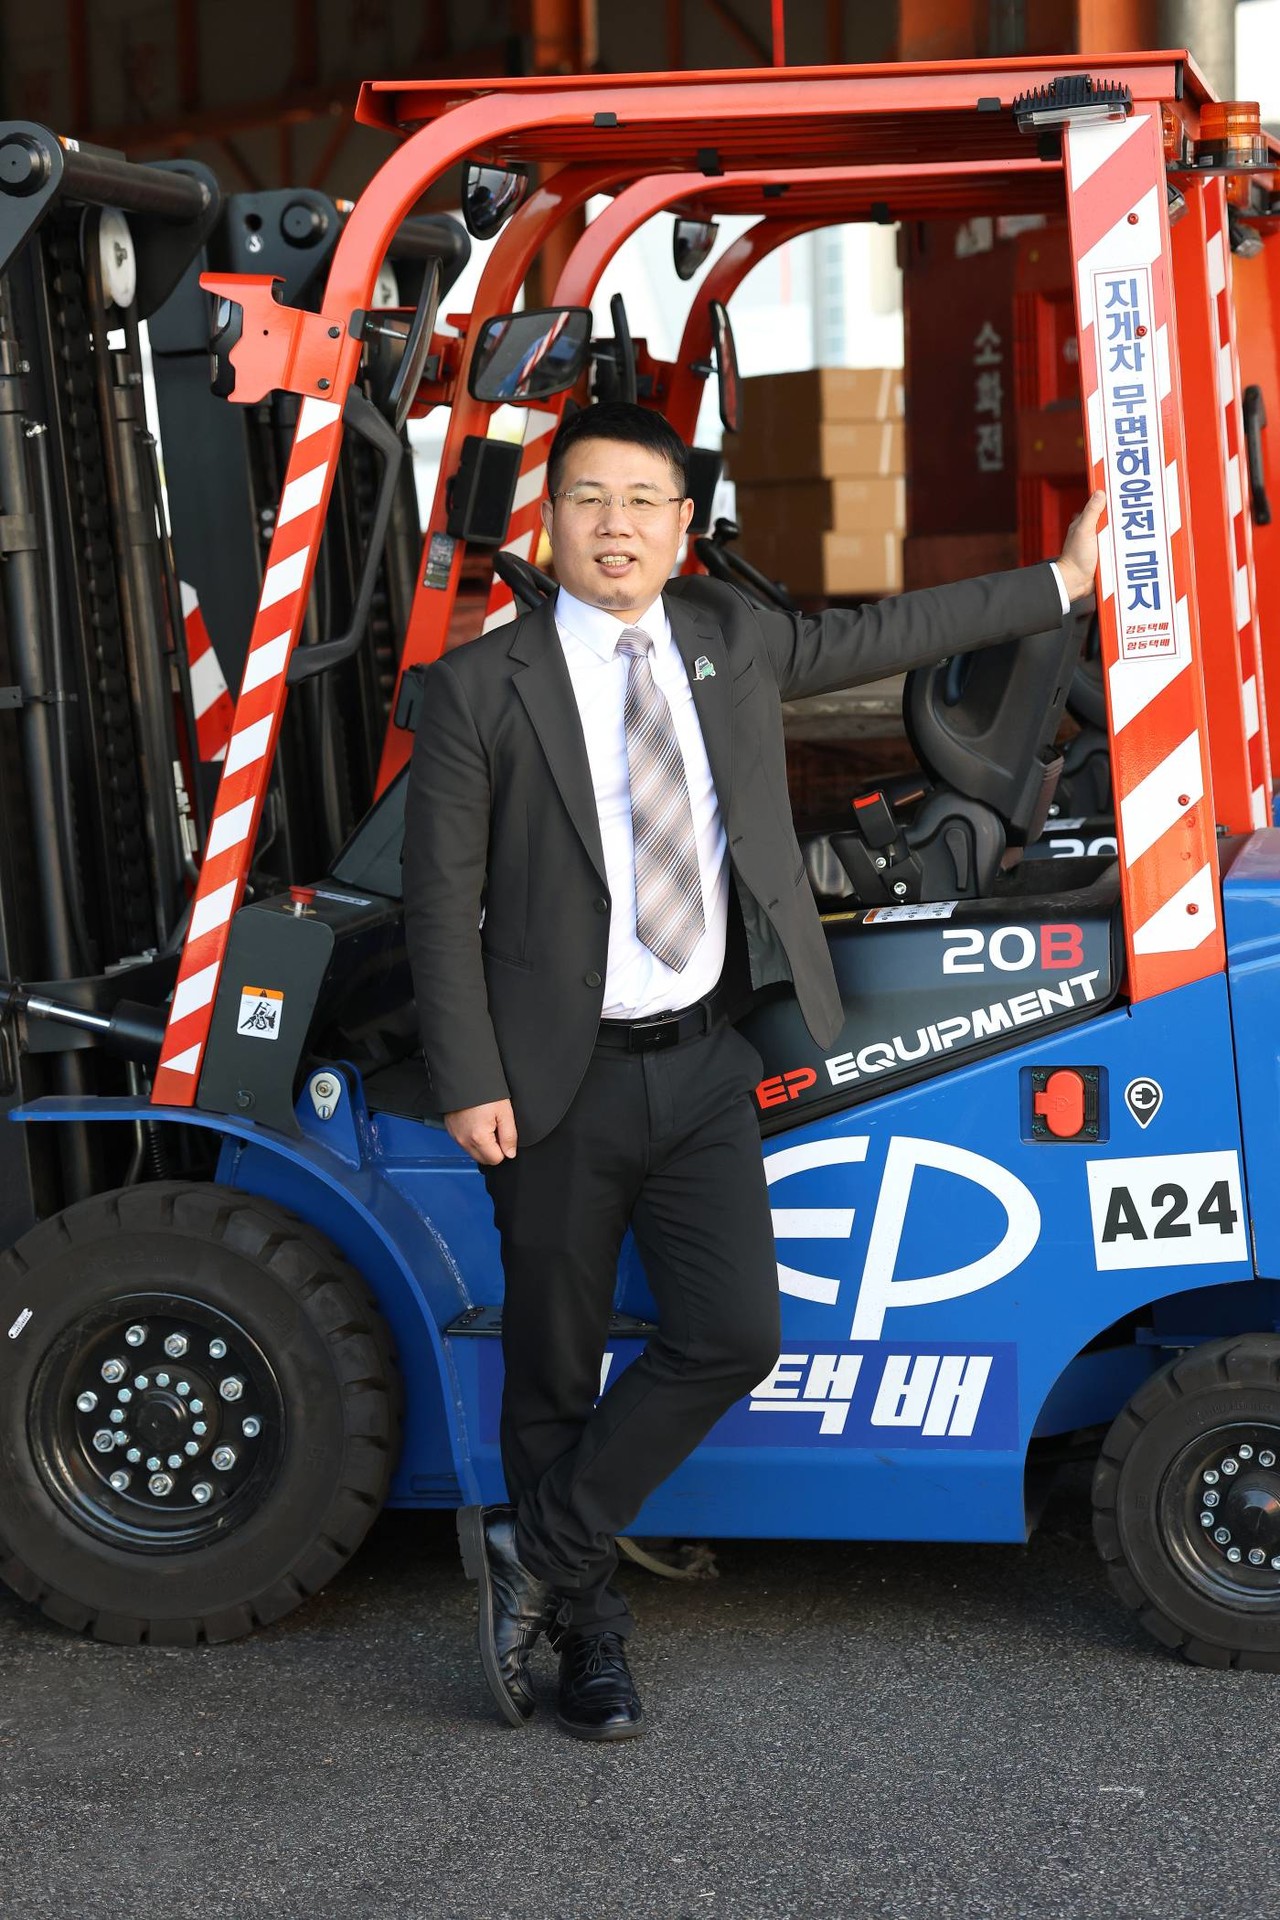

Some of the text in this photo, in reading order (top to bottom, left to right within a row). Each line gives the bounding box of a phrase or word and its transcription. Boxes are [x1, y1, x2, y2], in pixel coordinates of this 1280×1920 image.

[1104, 278, 1161, 611] 지게차 무면허운전 금지
[942, 923, 1085, 975] 20B
[755, 969, 1101, 1110] EP EQUIPMENT
[1101, 1180, 1238, 1243] A24
